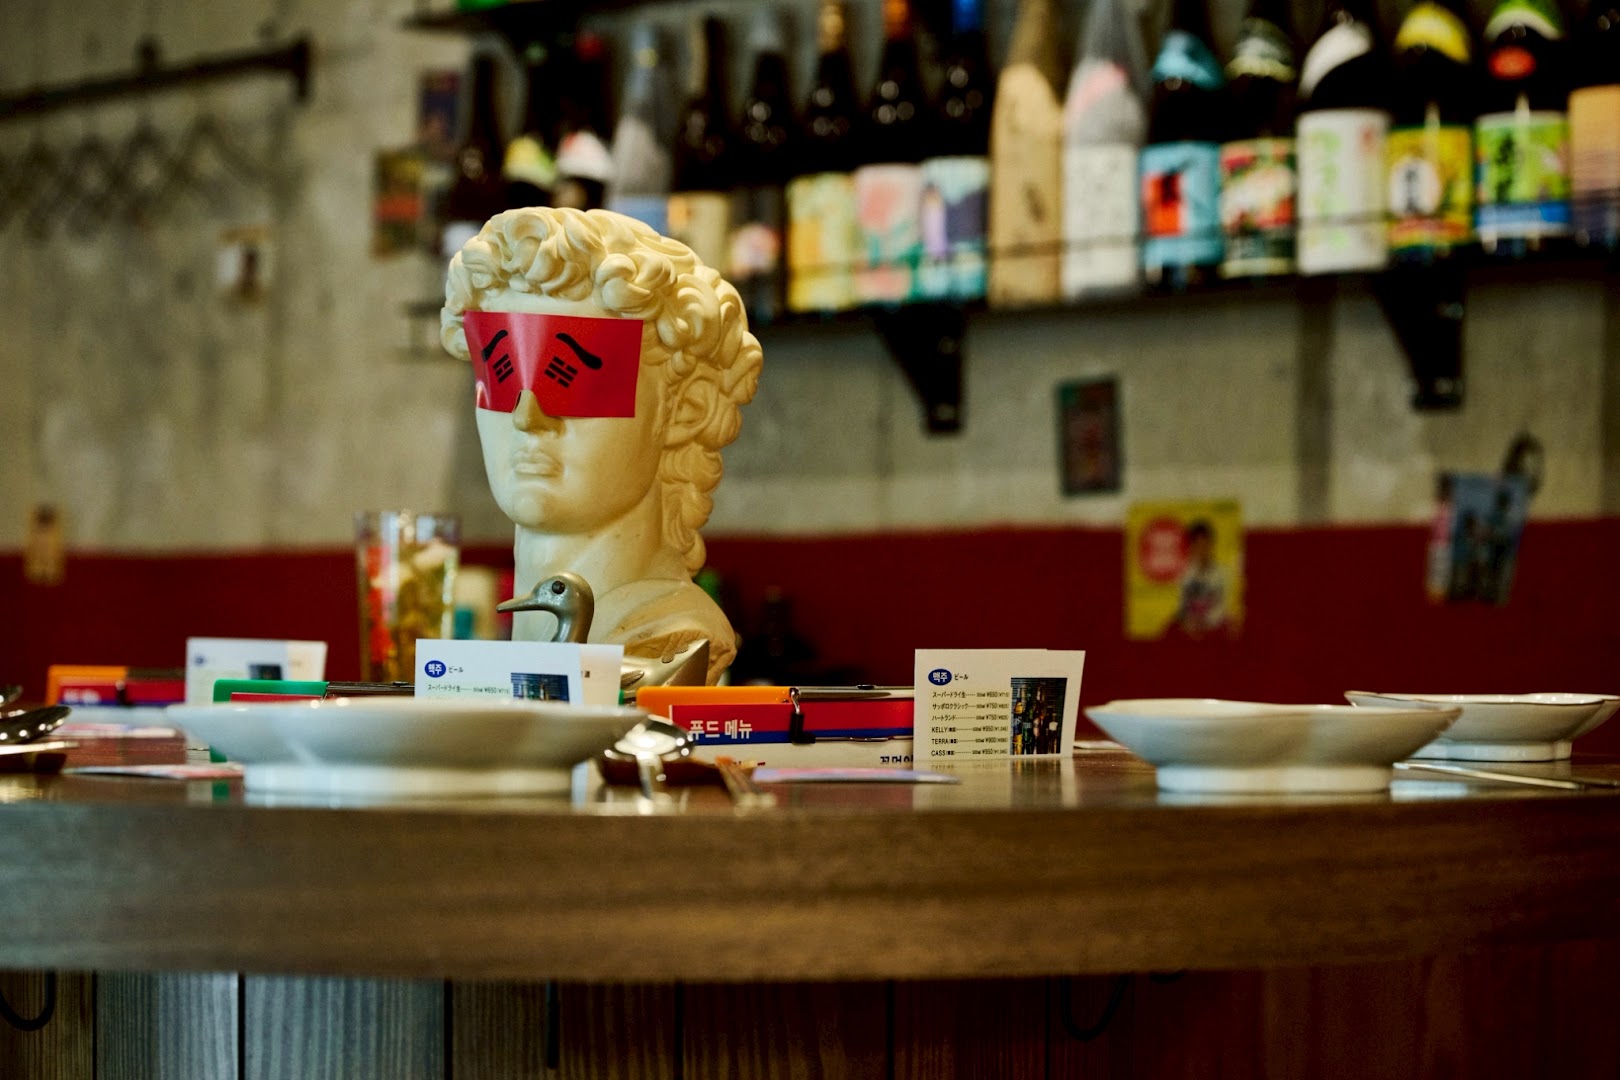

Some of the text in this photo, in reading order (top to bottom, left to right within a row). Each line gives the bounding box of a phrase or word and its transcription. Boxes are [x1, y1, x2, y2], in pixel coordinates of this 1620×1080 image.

[428, 663, 443, 675] 맥주
[932, 671, 969, 683] 맥주 ビール
[932, 691, 966, 699] スーパードライ生
[690, 719, 753, 741] 푸드 메뉴
[931, 749, 946, 757] CASS
